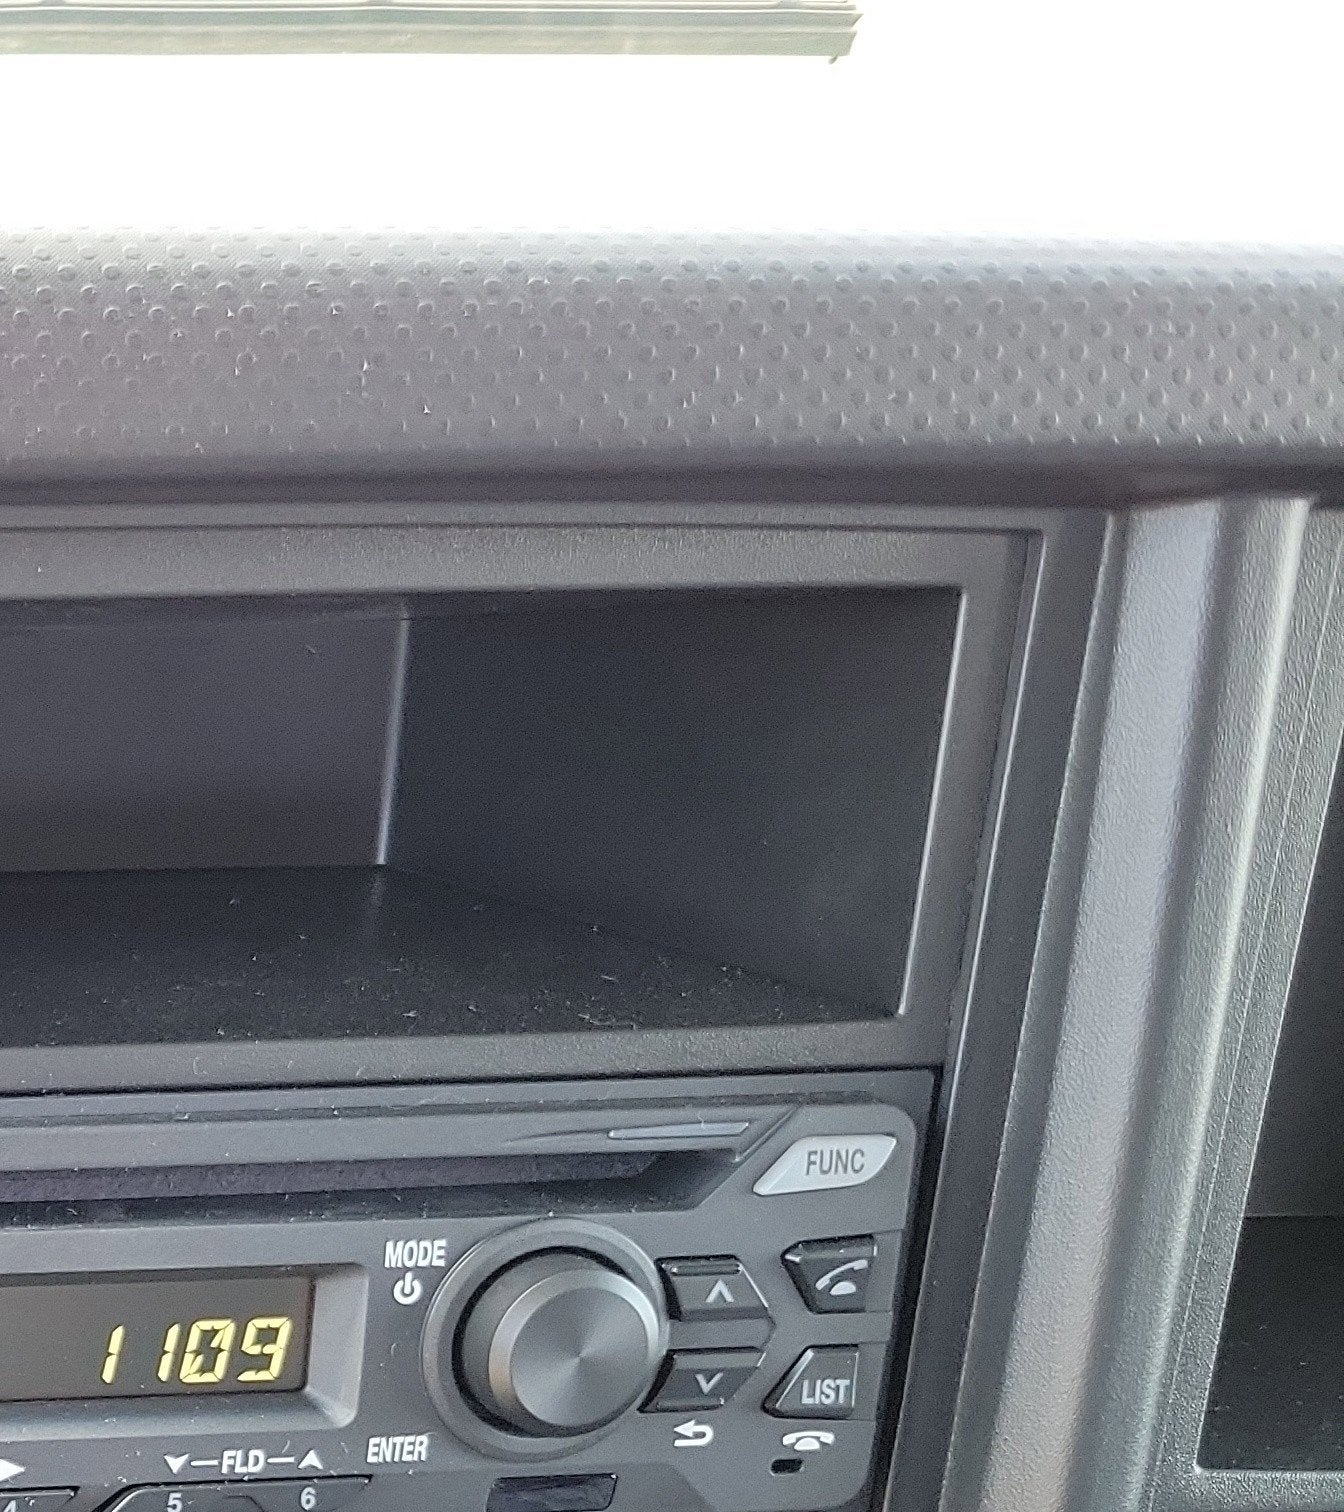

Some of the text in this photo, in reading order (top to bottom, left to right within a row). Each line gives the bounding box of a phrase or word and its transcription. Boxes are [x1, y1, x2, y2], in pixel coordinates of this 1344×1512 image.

[804, 1145, 866, 1176] FUNC
[384, 1238, 446, 1269] MODE
[800, 1377, 851, 1407] LIST
[221, 1448, 265, 1474] FLD
[366, 1433, 429, 1464] ENTER
[299, 1486, 317, 1511] 6
